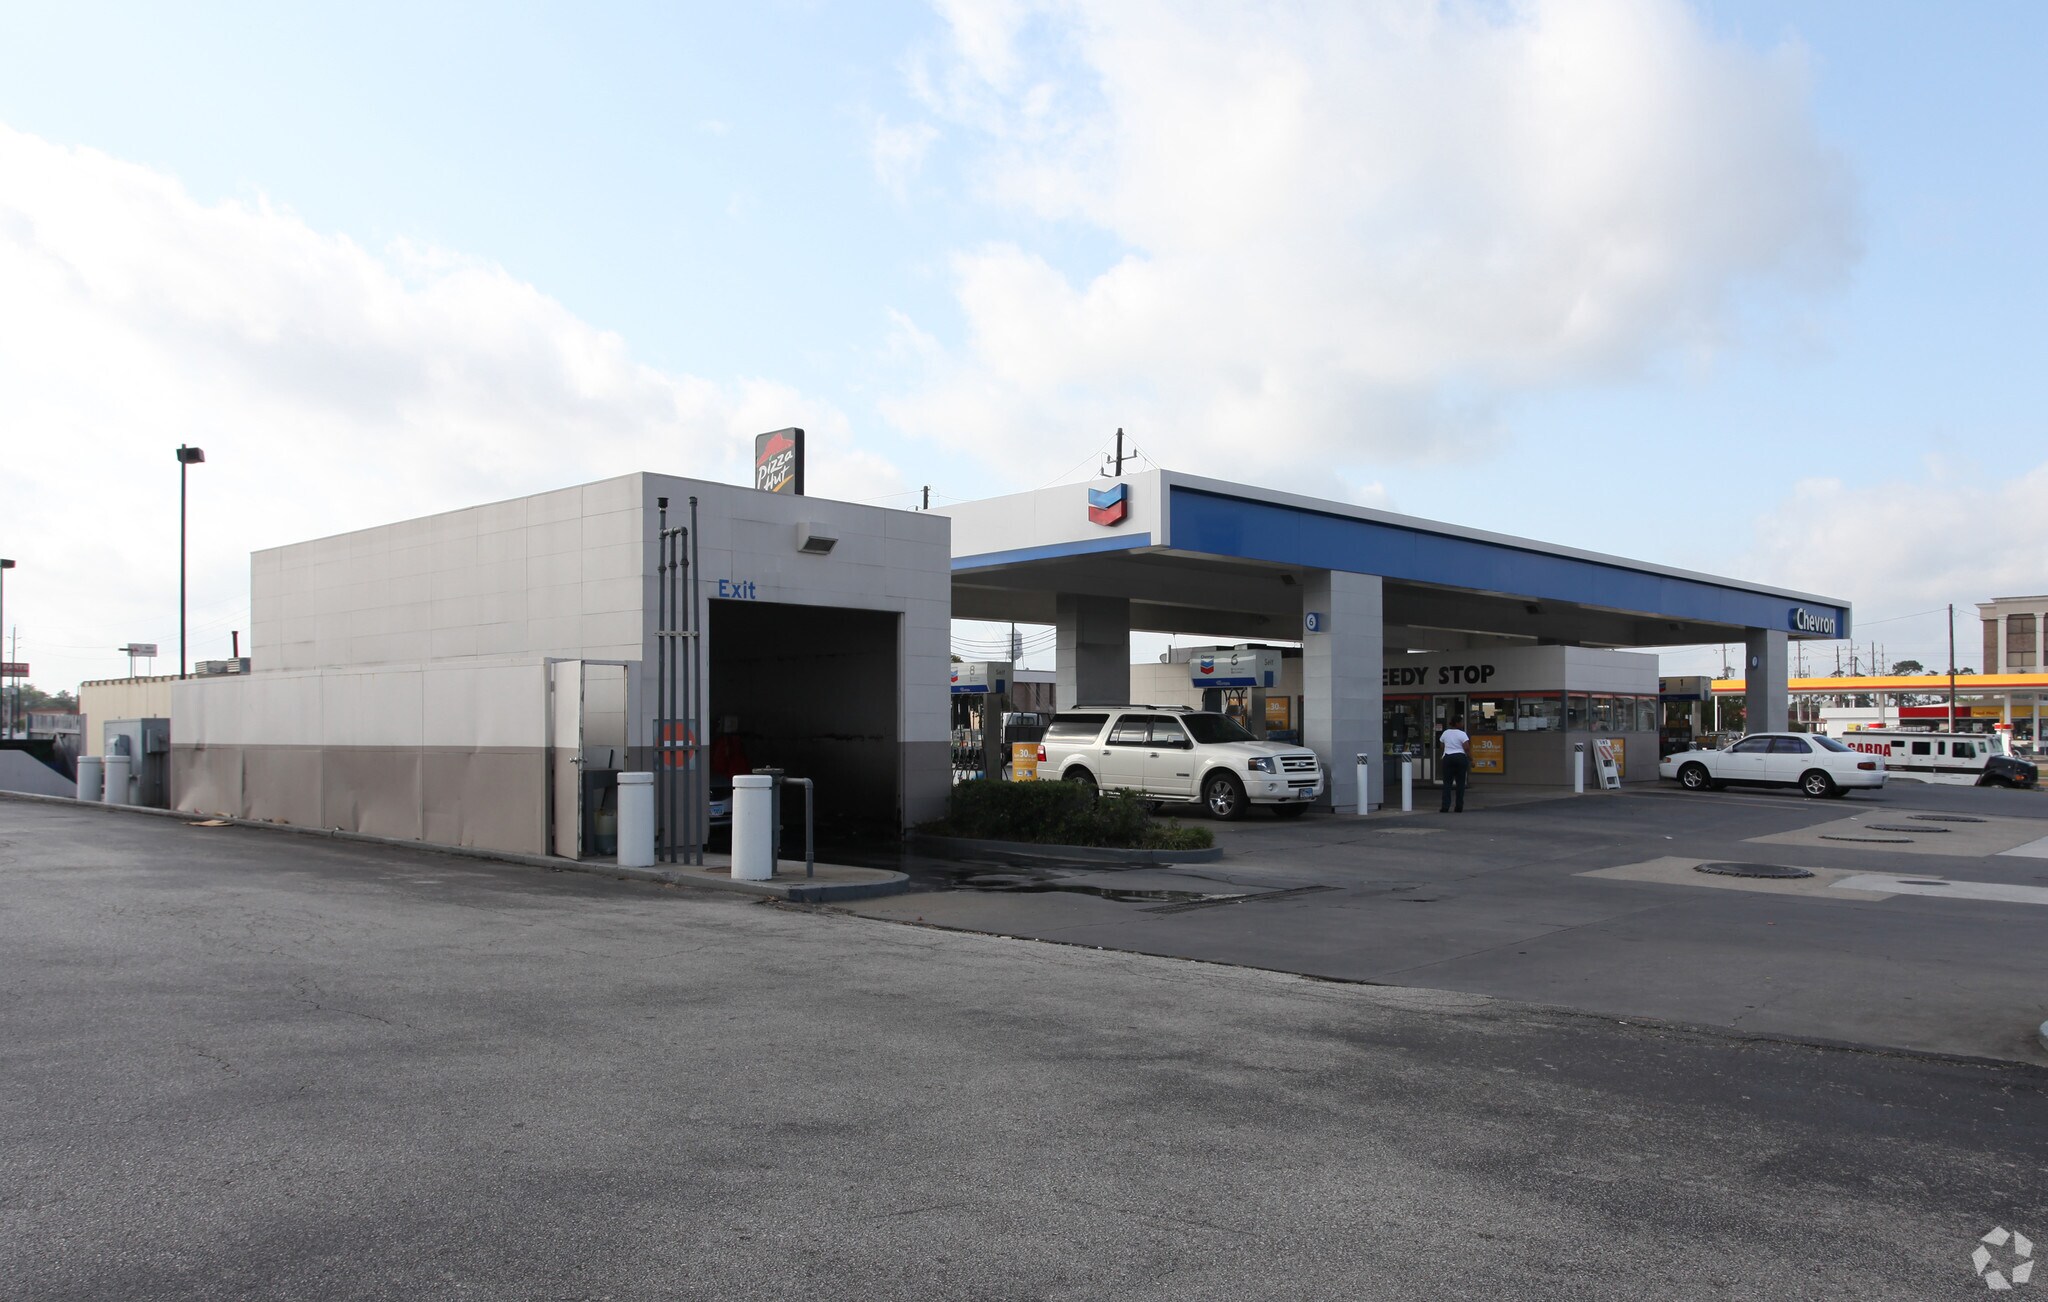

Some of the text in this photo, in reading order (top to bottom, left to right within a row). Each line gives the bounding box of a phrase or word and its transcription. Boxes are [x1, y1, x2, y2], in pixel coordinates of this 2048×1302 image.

[757, 450, 794, 490] Pizza
[764, 465, 790, 491] Hut
[718, 579, 756, 599] Exit
[1797, 607, 1836, 634] Chevron
[1231, 654, 1239, 666] 6
[1264, 658, 1274, 666] Self
[970, 665, 975, 676] 8
[1438, 665, 1495, 684] STOP
